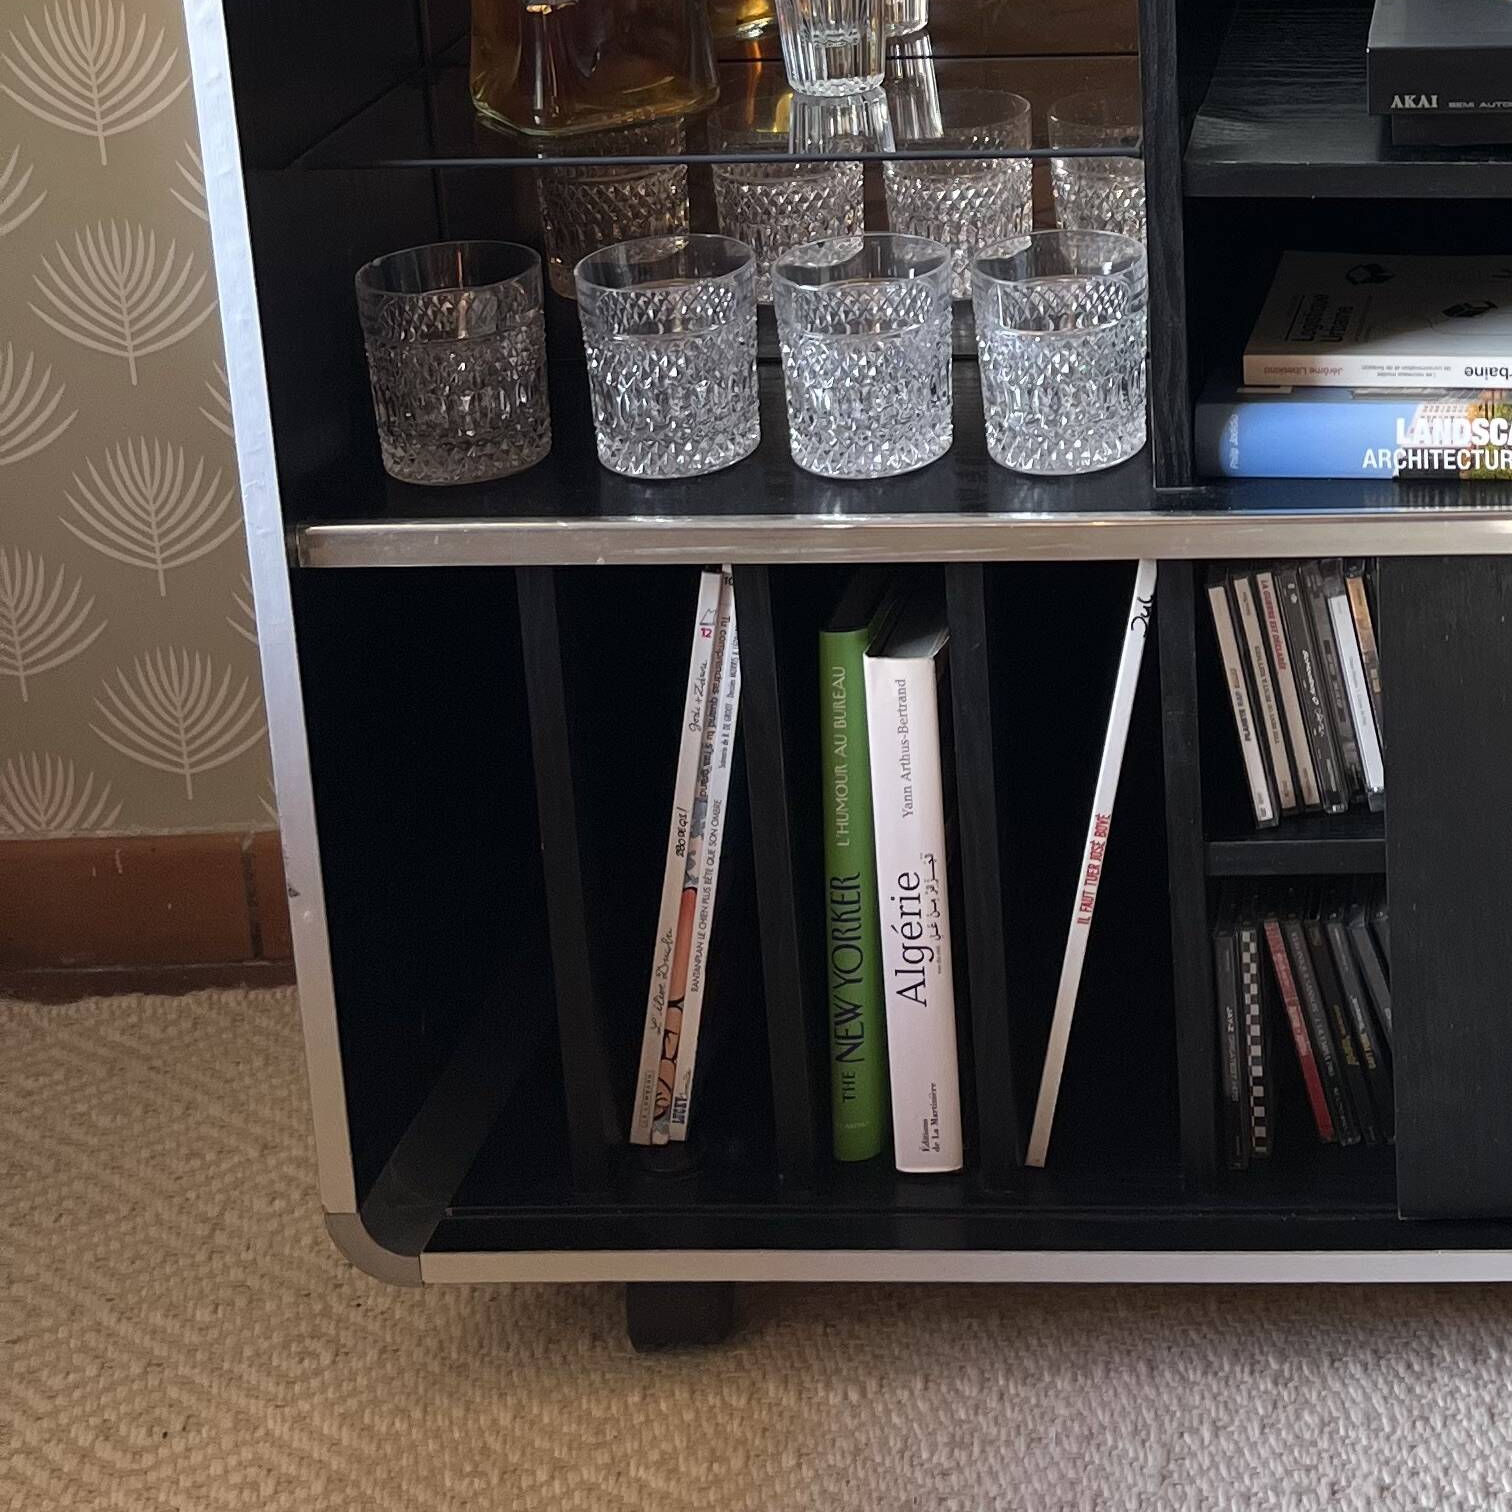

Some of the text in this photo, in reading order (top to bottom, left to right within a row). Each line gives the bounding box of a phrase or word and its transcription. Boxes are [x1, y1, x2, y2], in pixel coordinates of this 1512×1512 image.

[1391, 94, 1438, 109] AKAI
[700, 627, 712, 638] 12
[720, 616, 731, 627] Tu
[711, 630, 727, 694] comprendras
[707, 696, 719, 728] quand
[831, 666, 851, 847] L'HUMOUR AU BUREAU
[896, 678, 914, 819] Yann Arthus-Bertrand
[711, 799, 722, 826] OMBRE
[709, 829, 718, 846] SON
[1088, 839, 1105, 861] JOSÉ
[706, 847, 716, 865] QUE
[702, 867, 714, 887] BÊTE
[1084, 864, 1100, 886] TUER
[701, 887, 712, 905] PLUS
[1079, 891, 1095, 912] FAUT
[699, 905, 708, 930] CHIEN
[830, 871, 864, 993] YORKER
[890, 871, 934, 1008] Algérie
[691, 941, 705, 993] RANTANPLAN
[832, 994, 865, 1064] NEW
[842, 1071, 857, 1103] THE
